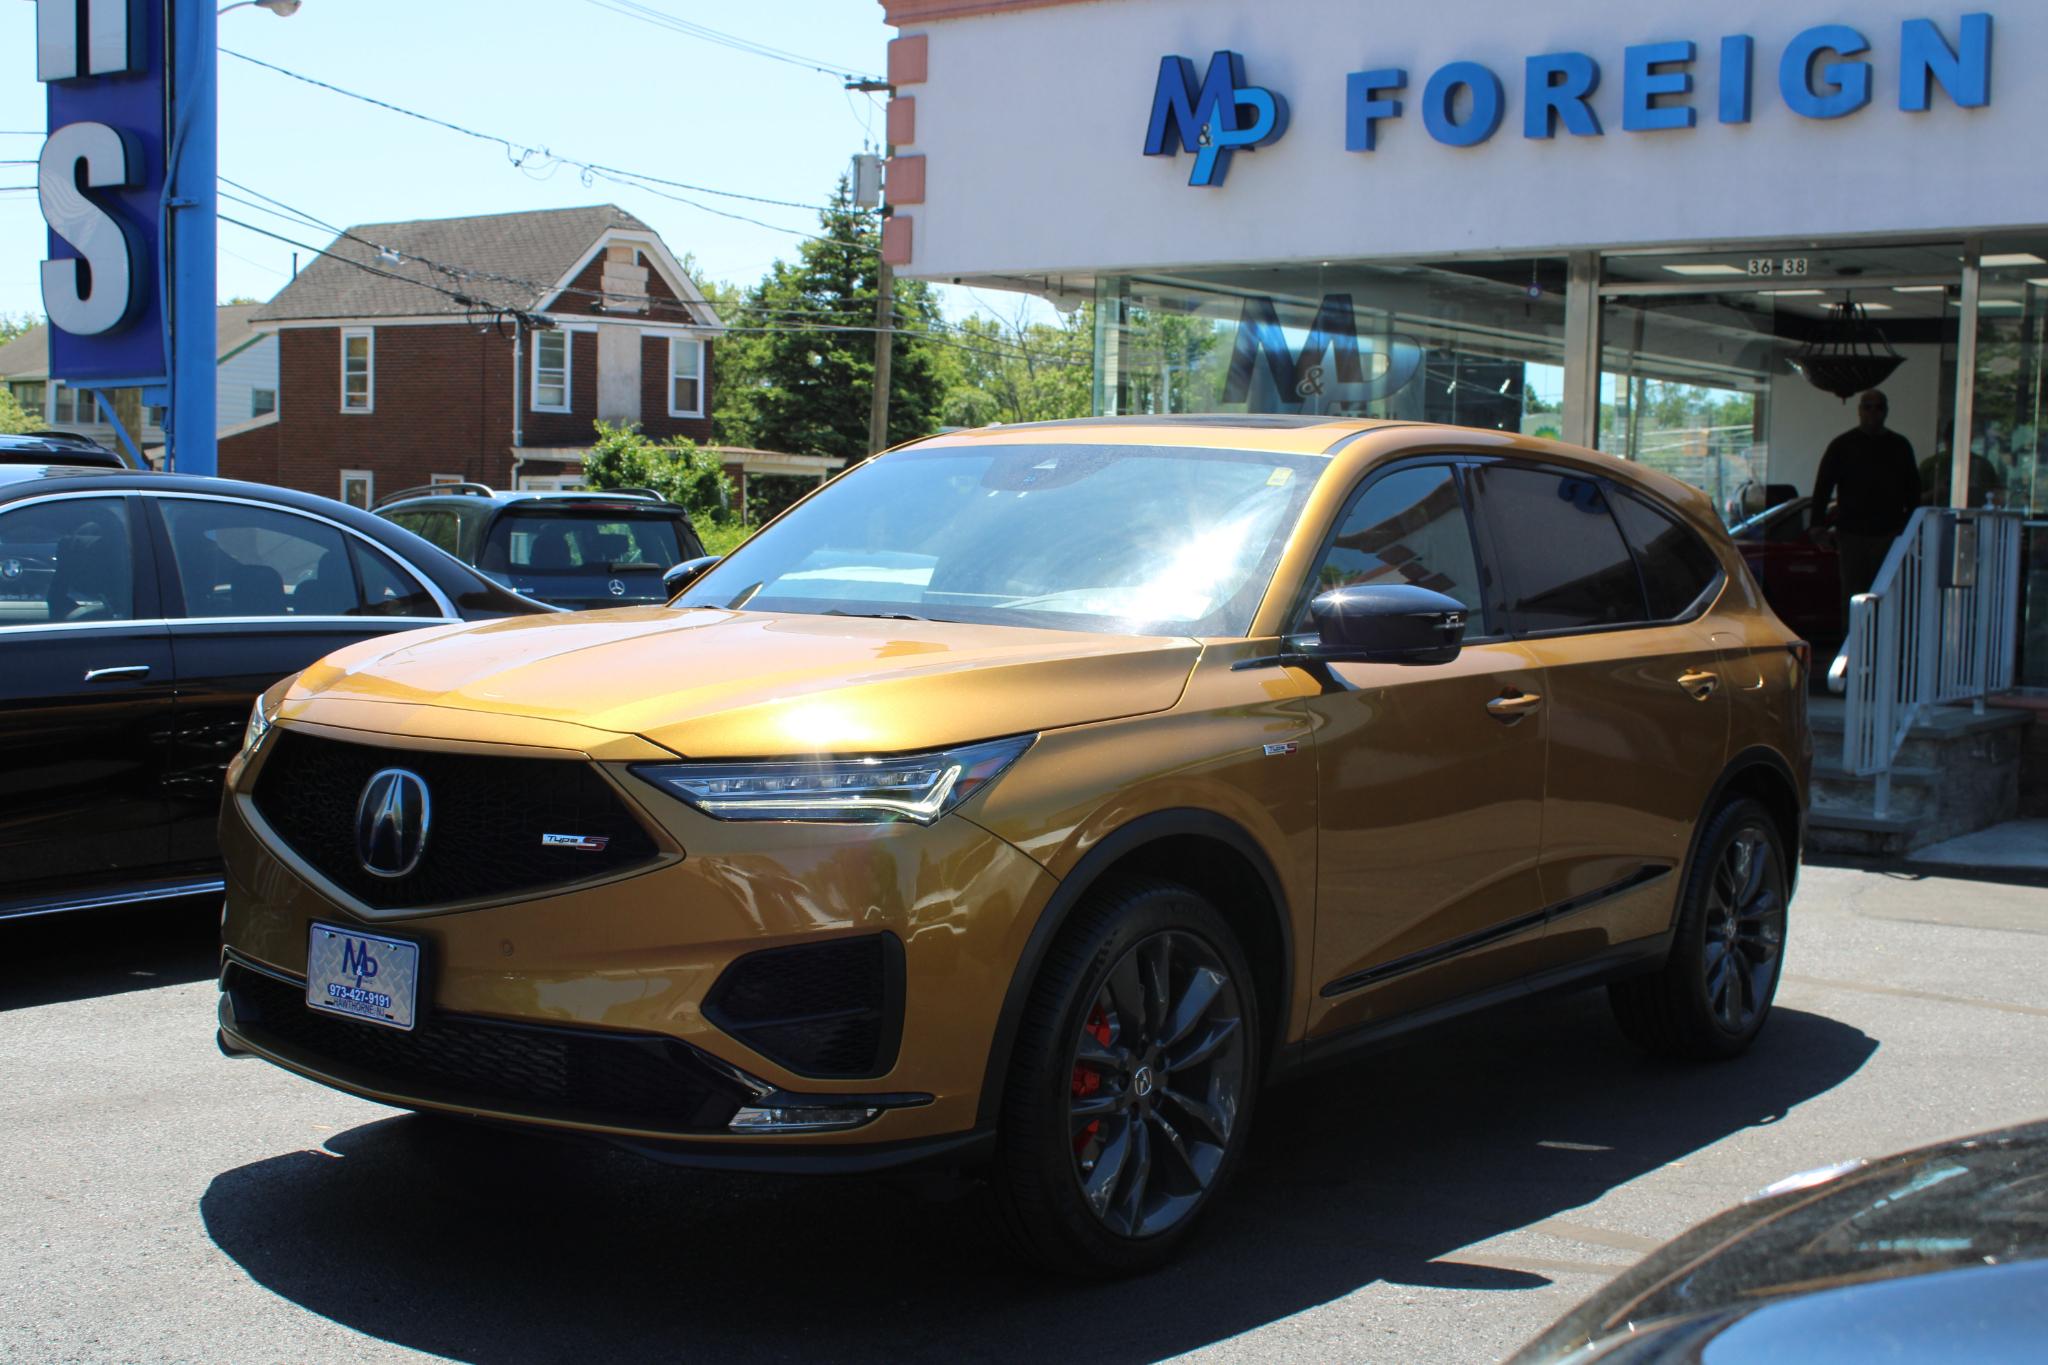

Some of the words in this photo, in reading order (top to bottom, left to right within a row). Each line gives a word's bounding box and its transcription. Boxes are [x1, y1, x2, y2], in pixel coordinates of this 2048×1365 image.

[1345, 12, 1993, 151] FOREIGN
[1749, 259, 1806, 275] 36-38
[329, 984, 390, 1008] 973-427-9191
